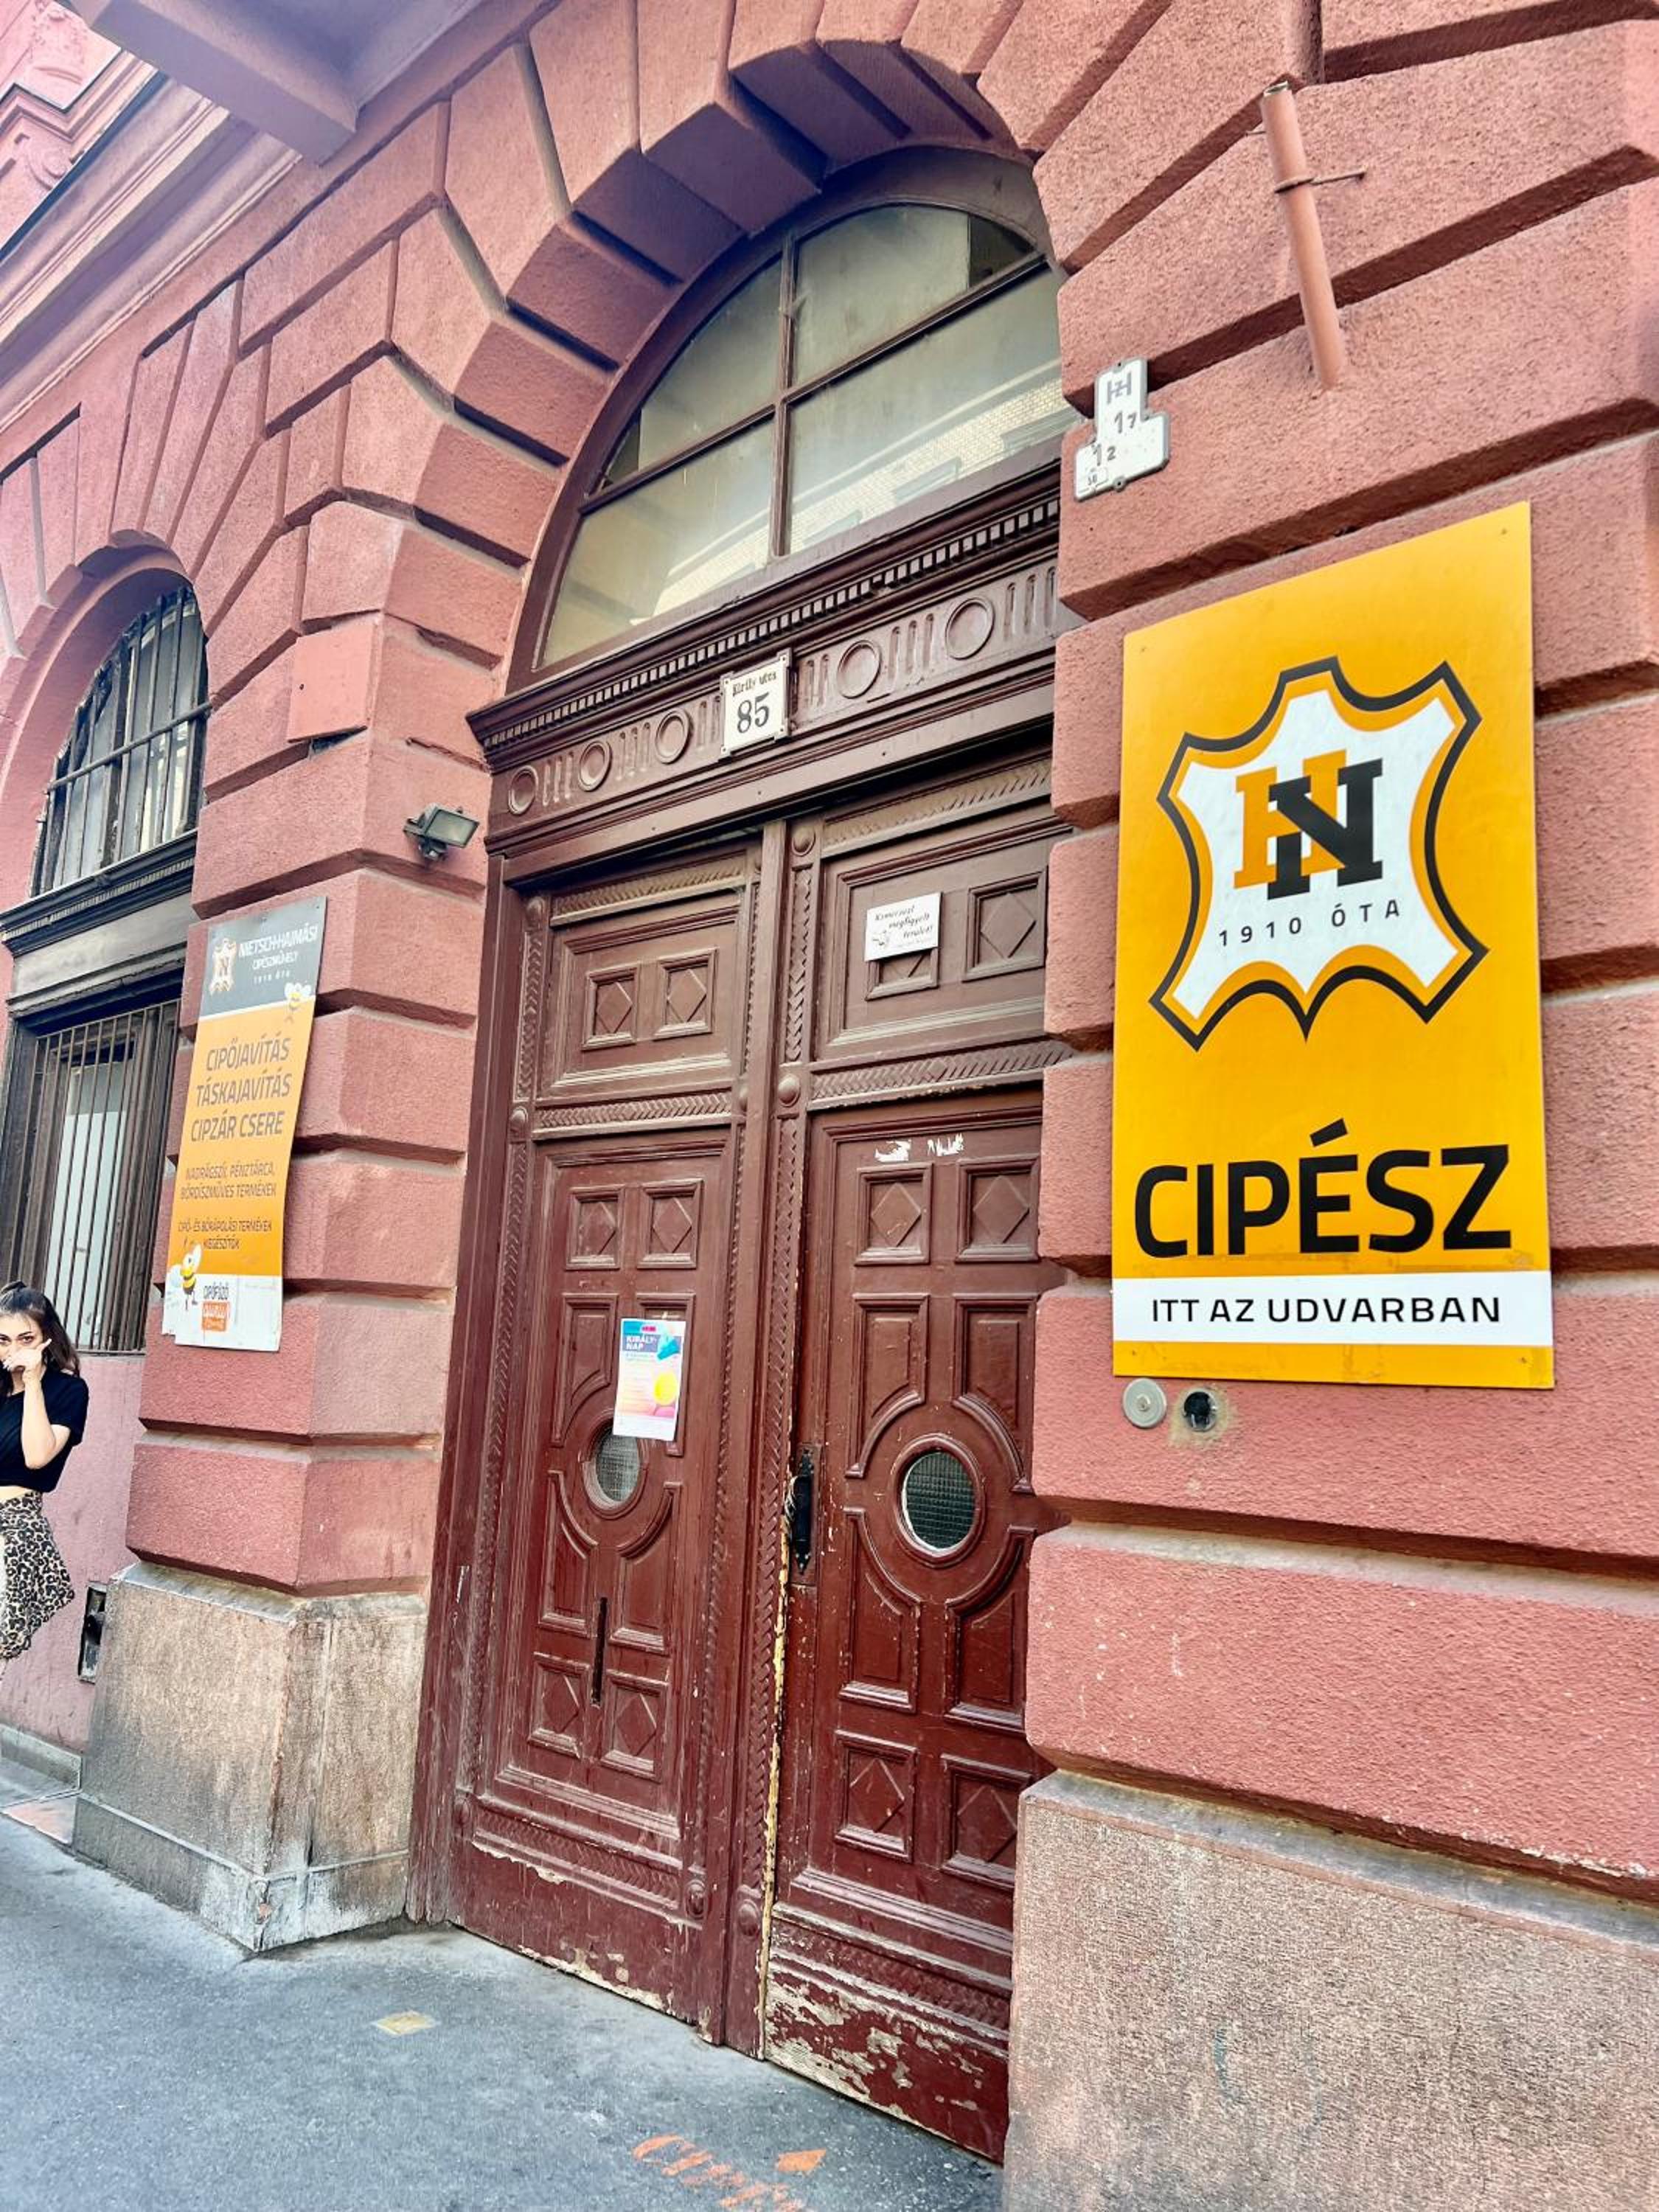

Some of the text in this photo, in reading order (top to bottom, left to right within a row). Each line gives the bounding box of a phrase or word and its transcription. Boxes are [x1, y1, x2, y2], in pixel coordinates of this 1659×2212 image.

[1114, 411, 1137, 434] 17
[1092, 444, 1116, 466] 12
[737, 691, 770, 734] 85
[1218, 898, 1400, 947] 1910 ÓTA
[206, 1031, 291, 1071] CIPŐJAVÍTÁS
[196, 1066, 293, 1107] TÁSKAJAVÍTÁS
[191, 1108, 285, 1142] CIPZÁR CSERE
[1134, 1117, 1512, 1259] CIPÉSZ
[1152, 1295, 1500, 1323] ITT AZ UDVARBAN
